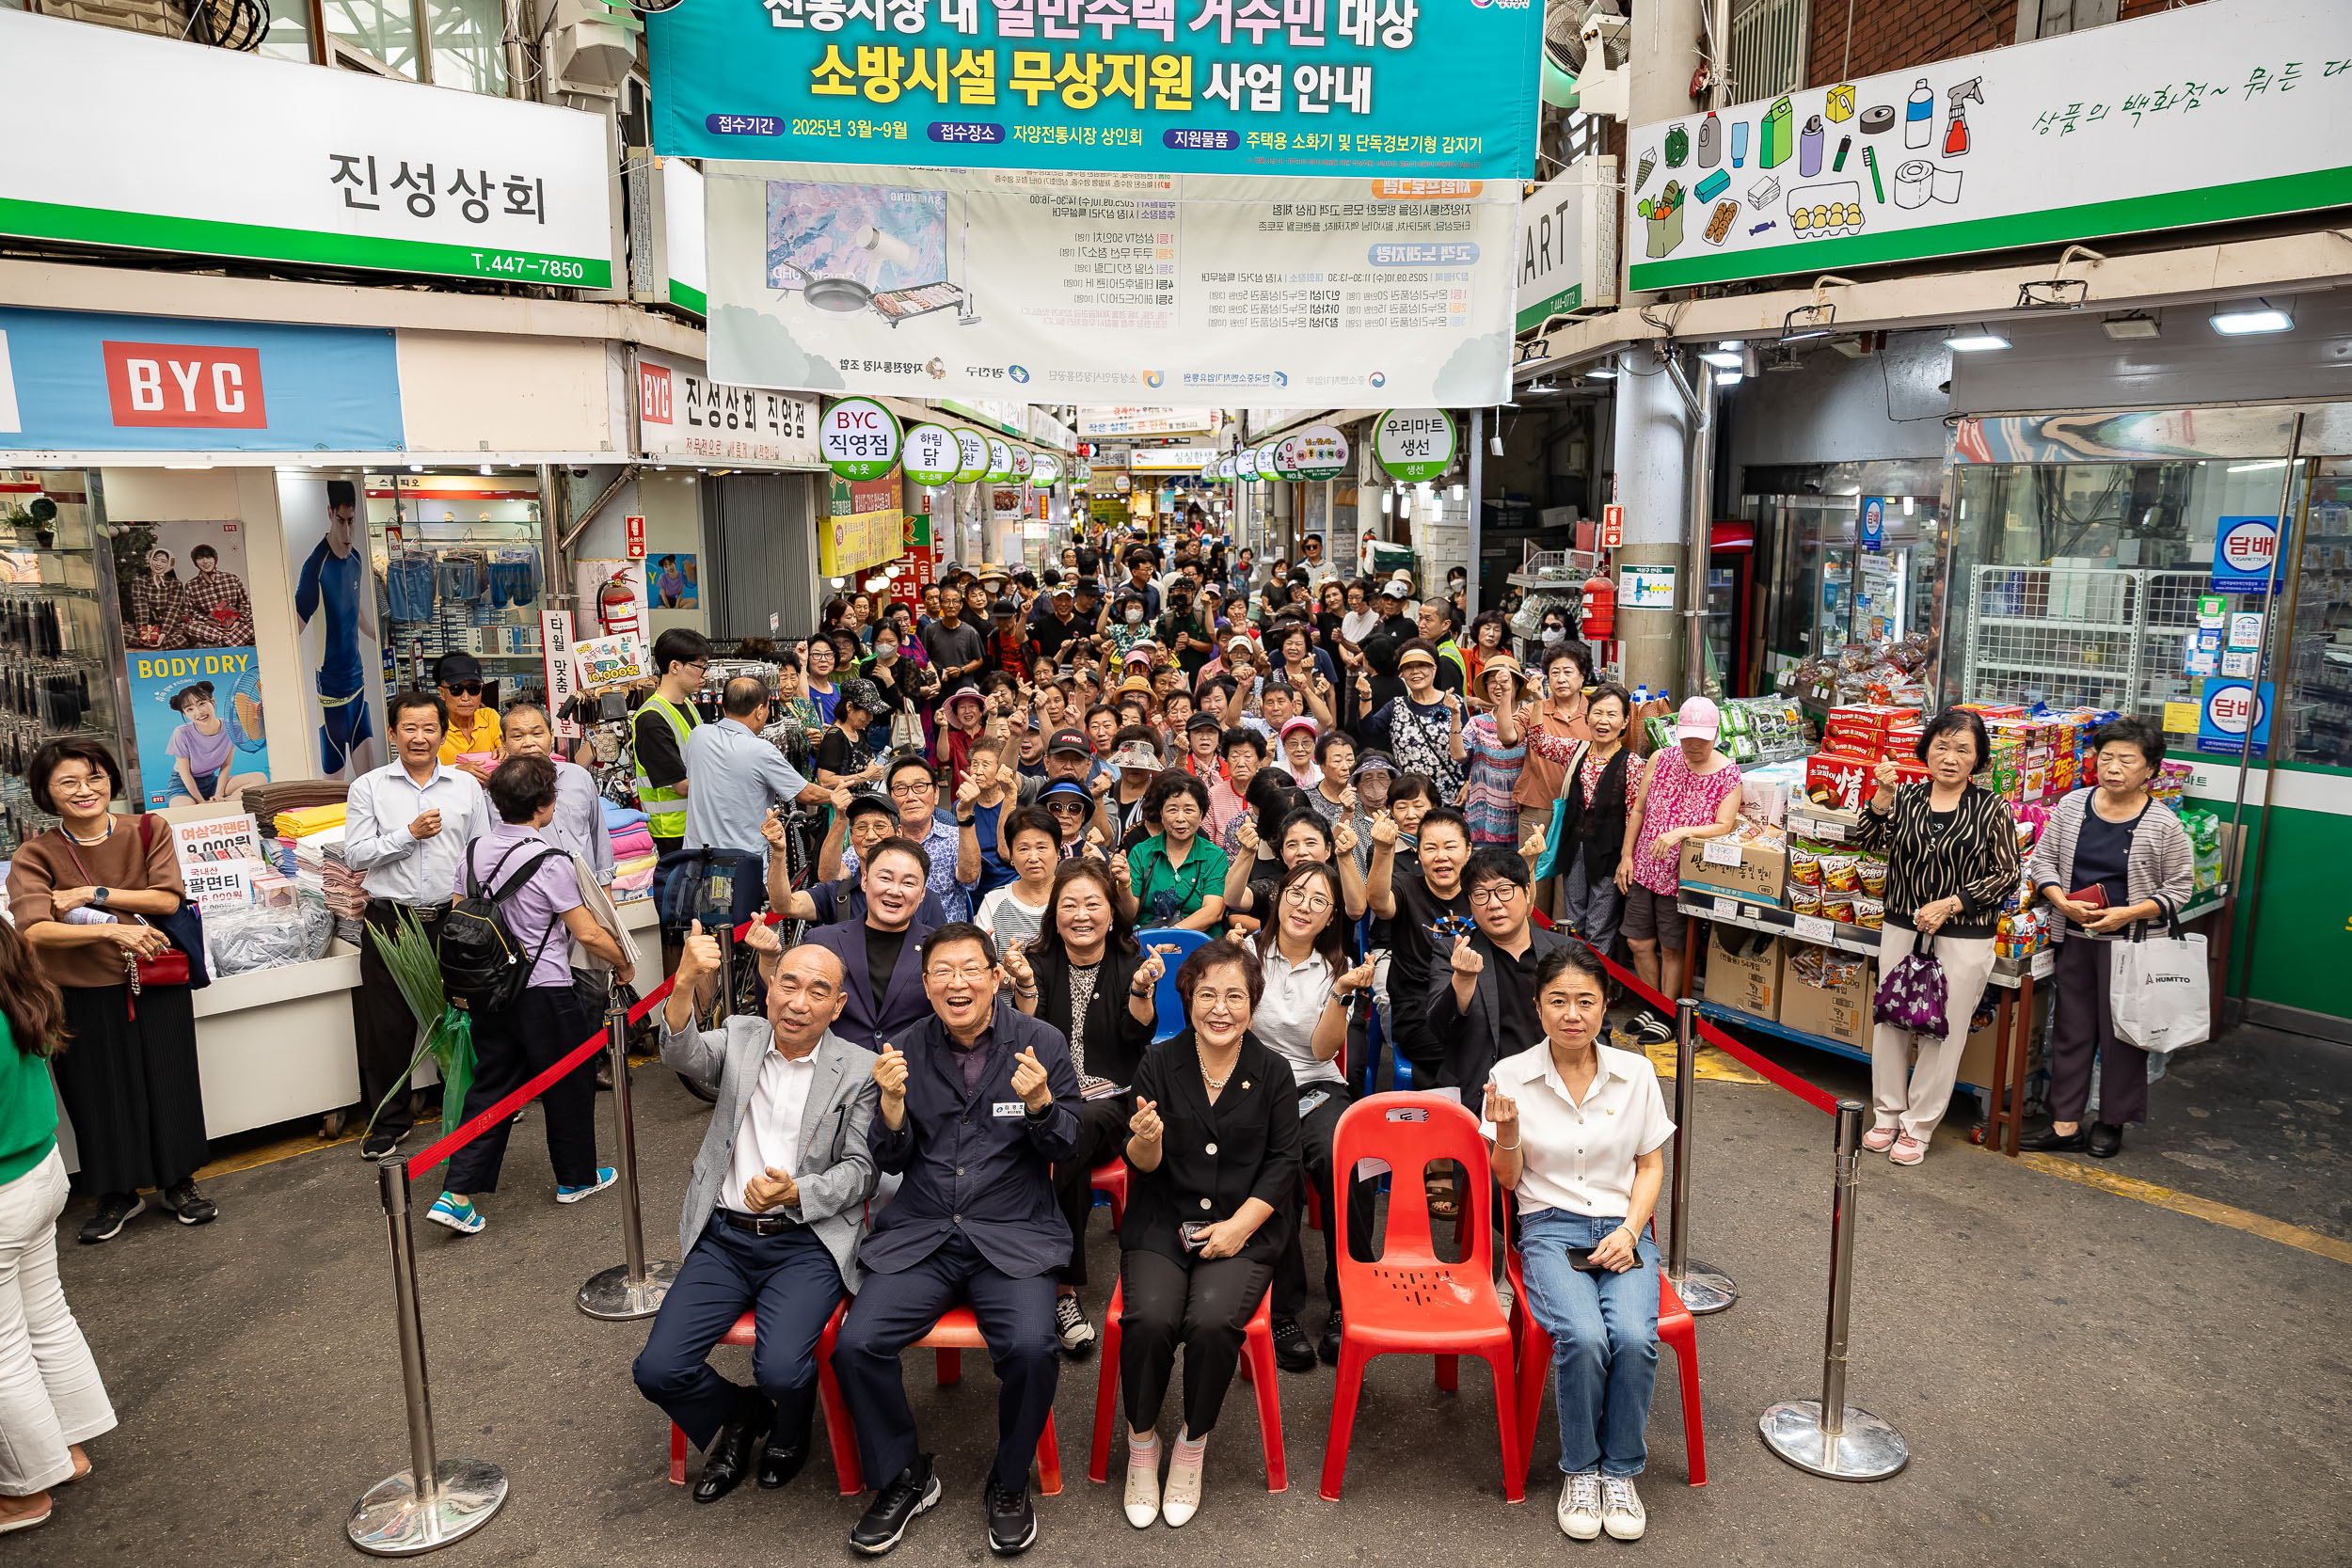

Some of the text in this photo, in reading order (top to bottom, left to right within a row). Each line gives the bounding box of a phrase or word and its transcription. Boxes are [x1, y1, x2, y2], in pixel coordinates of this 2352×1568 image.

[993, 0, 1174, 42] 일반주택
[1188, 0, 1325, 46] 거주민
[1338, 0, 1419, 48] 대상
[811, 44, 1373, 114] 소방시설 무상지원 사업 안내
[2032, 103, 2110, 136] 상품의
[2244, 63, 2303, 101] 뭐든
[2324, 58, 2352, 76] 다
[718, 117, 907, 139] 접수기간 2025년 3월~9월
[941, 124, 1142, 146] 접수장소 자양전통시장 상인회
[1175, 131, 1482, 154] 지원물품 주택용 소화기 및 단독경보기형 감지기
[329, 153, 546, 225] 진성상회
[1518, 199, 1567, 288] ART
[471, 252, 582, 280] T.447-7850
[127, 358, 246, 413] BYC
[644, 373, 669, 419] BYC
[686, 378, 804, 438] 진성상회 직영점
[837, 411, 878, 429] BYC
[1386, 420, 1444, 436] 우리마트
[830, 434, 888, 455] 직영점
[920, 434, 942, 444] 하림
[1401, 439, 1429, 456] 생선
[923, 449, 939, 467] 닭
[848, 464, 869, 474] 속옷
[1406, 465, 1423, 475] 생선
[379, 478, 420, 487] 스피오
[2230, 537, 2274, 556] 담배
[891, 581, 917, 599] 오리
[602, 643, 629, 656] SALE
[138, 655, 248, 678] BODY DRY
[550, 618, 572, 735] 타월 맞춤 문
[588, 665, 640, 682] 10,000원
[1692, 712, 1702, 722] W
[1810, 768, 1836, 781] 초코파이
[2055, 757, 2072, 778] ZEC
[1836, 766, 1865, 814] 情
[182, 820, 250, 841] 여삼각팬티
[187, 835, 250, 853] 9000원
[190, 867, 218, 876] 국내산
